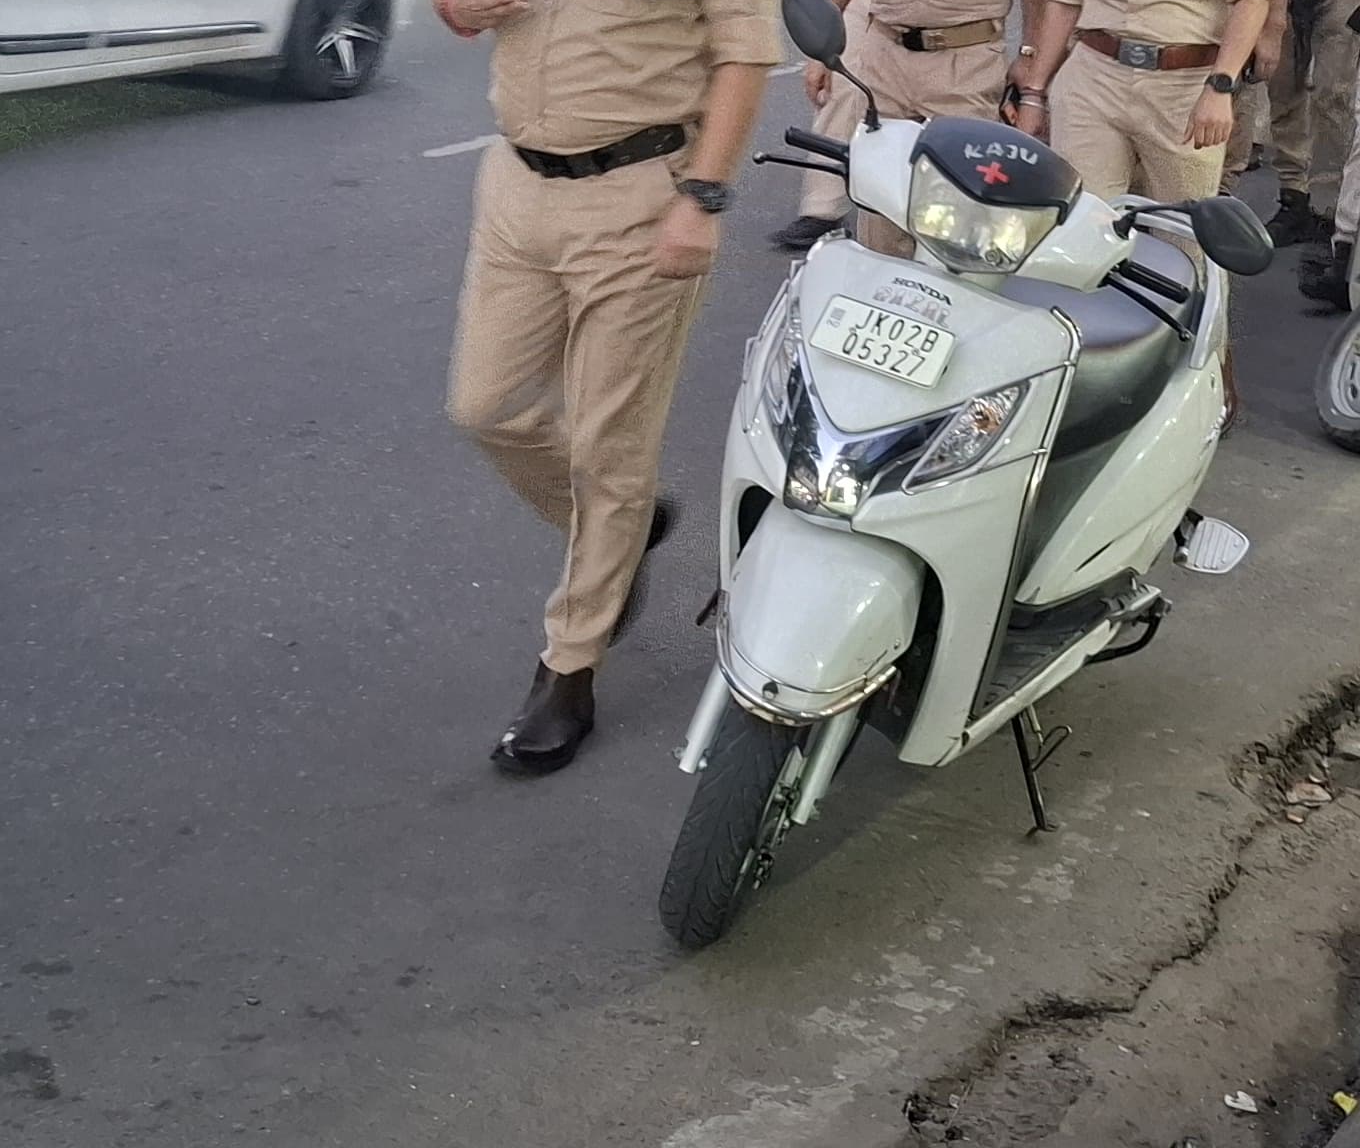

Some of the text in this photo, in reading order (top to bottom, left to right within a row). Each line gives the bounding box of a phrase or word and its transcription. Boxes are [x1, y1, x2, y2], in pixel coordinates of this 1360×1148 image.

[964, 142, 1038, 165] KAJU
[893, 277, 952, 306] HONDA
[855, 309, 940, 353] JK02B
